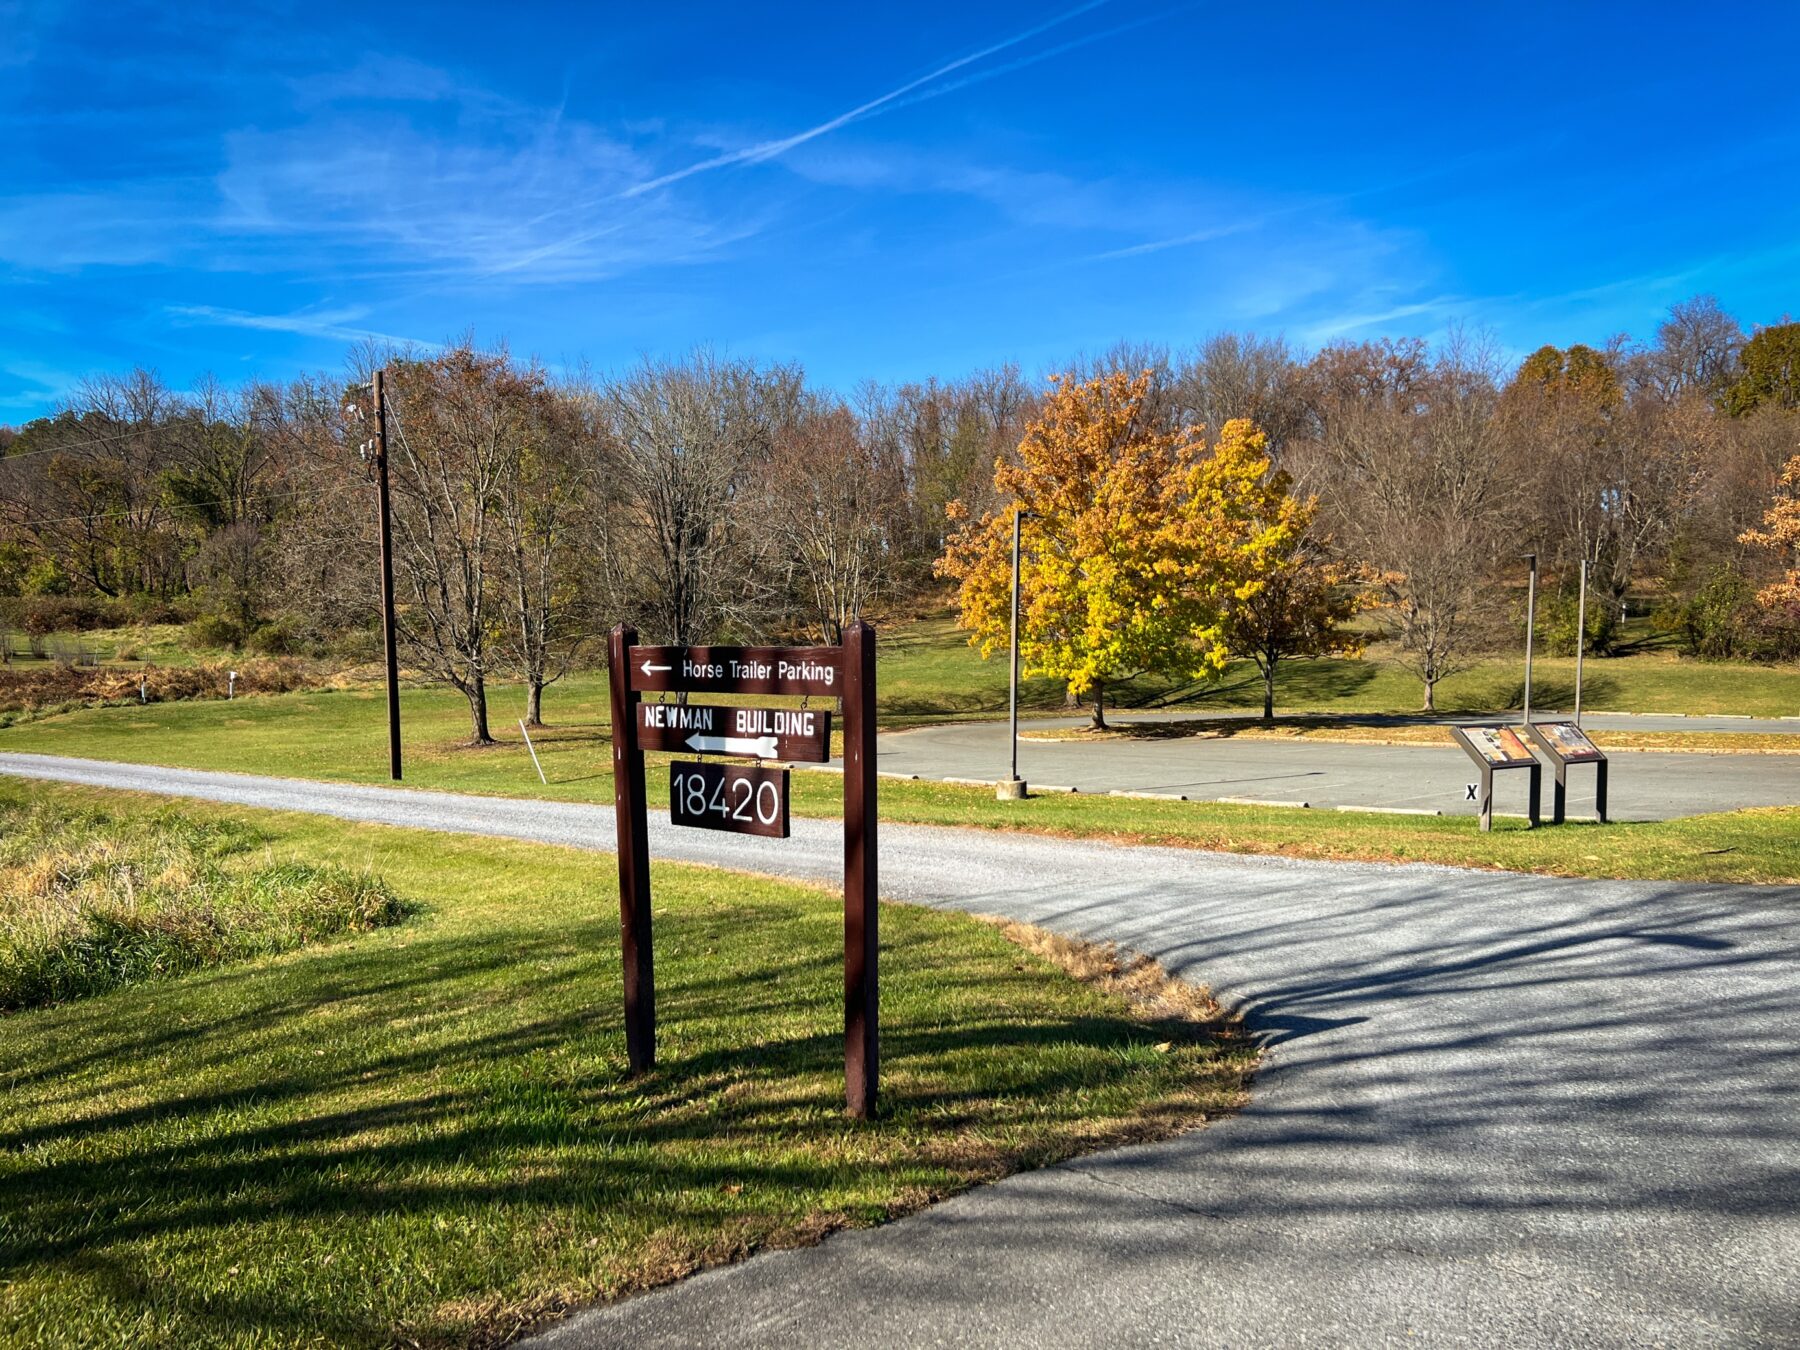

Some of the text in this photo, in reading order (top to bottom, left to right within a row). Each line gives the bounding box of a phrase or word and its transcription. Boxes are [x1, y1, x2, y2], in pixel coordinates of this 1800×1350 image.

[683, 659, 834, 685] Horse Trailer Parking
[645, 705, 815, 736] NEWMAN BUILDING
[673, 773, 779, 825] 18420
